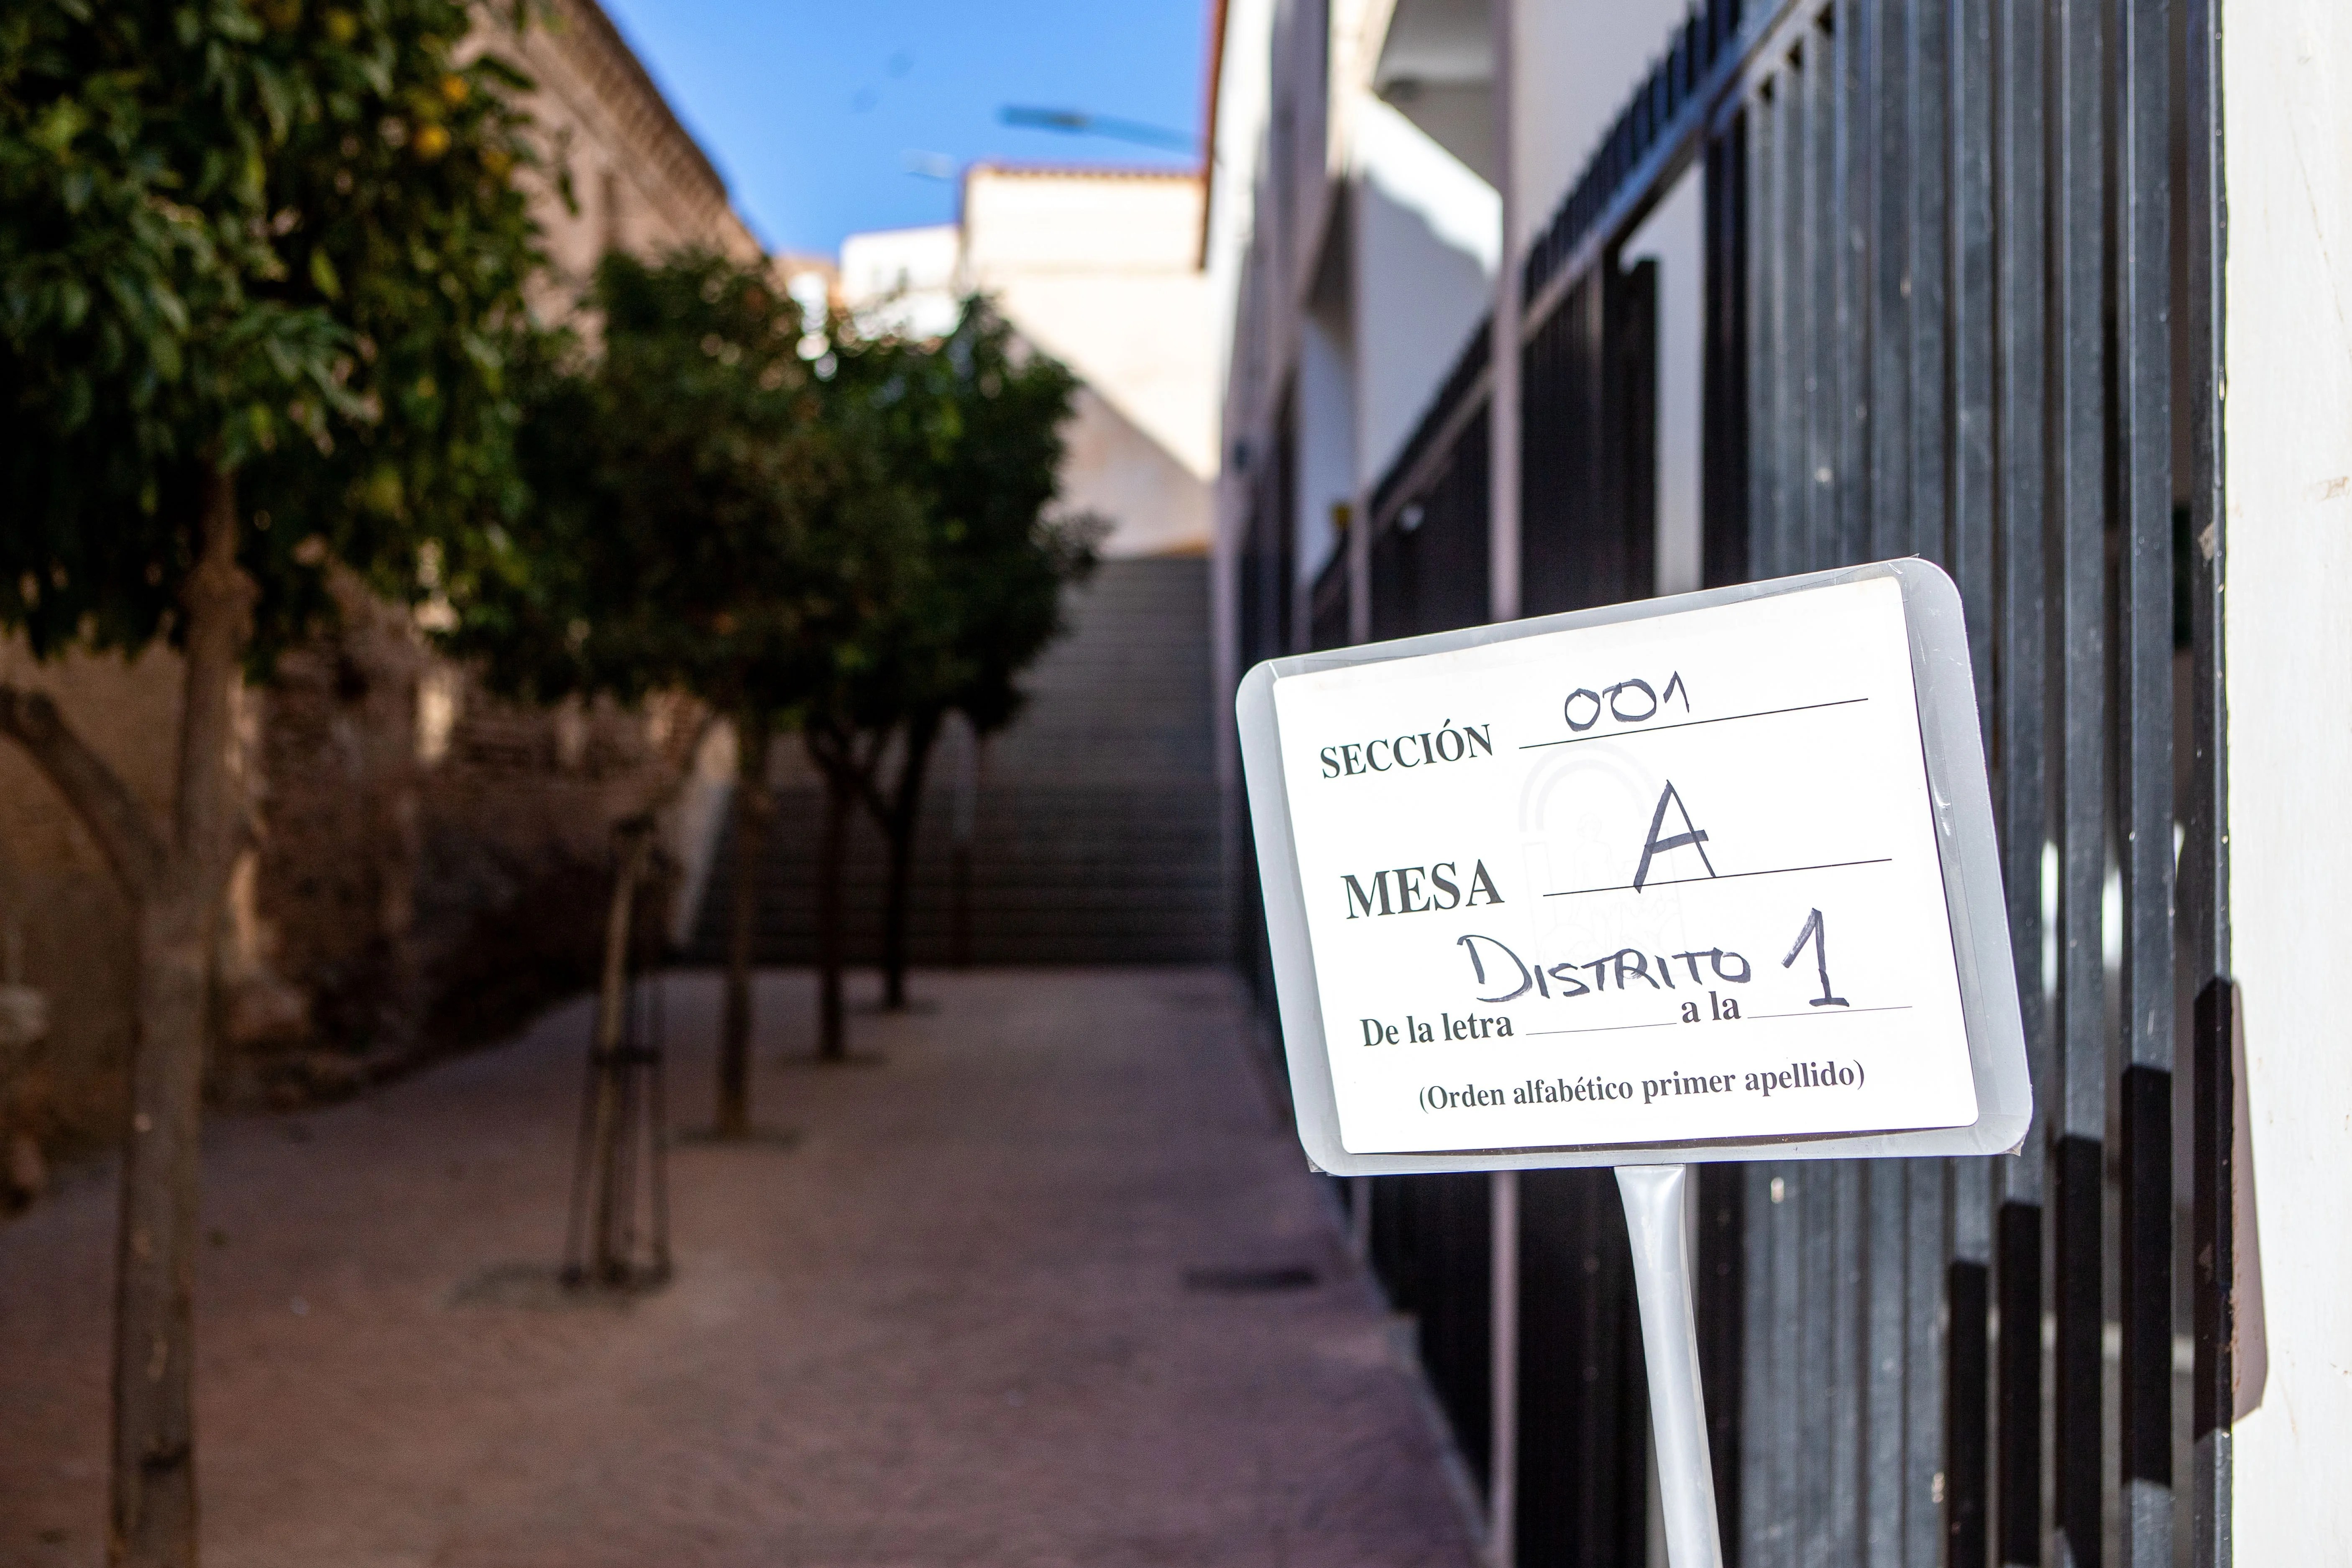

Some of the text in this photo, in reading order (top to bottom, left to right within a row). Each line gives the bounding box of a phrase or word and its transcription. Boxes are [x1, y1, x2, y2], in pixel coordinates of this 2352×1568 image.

[1320, 670, 1690, 779] SECCIÓN 001
[1340, 779, 1717, 920] MESA A
[1456, 907, 1850, 1008] DISTRITO 1
[1359, 990, 1742, 1047] De la letra a la
[1419, 1059, 1865, 1113] (Orden alfabético primer apellido)
